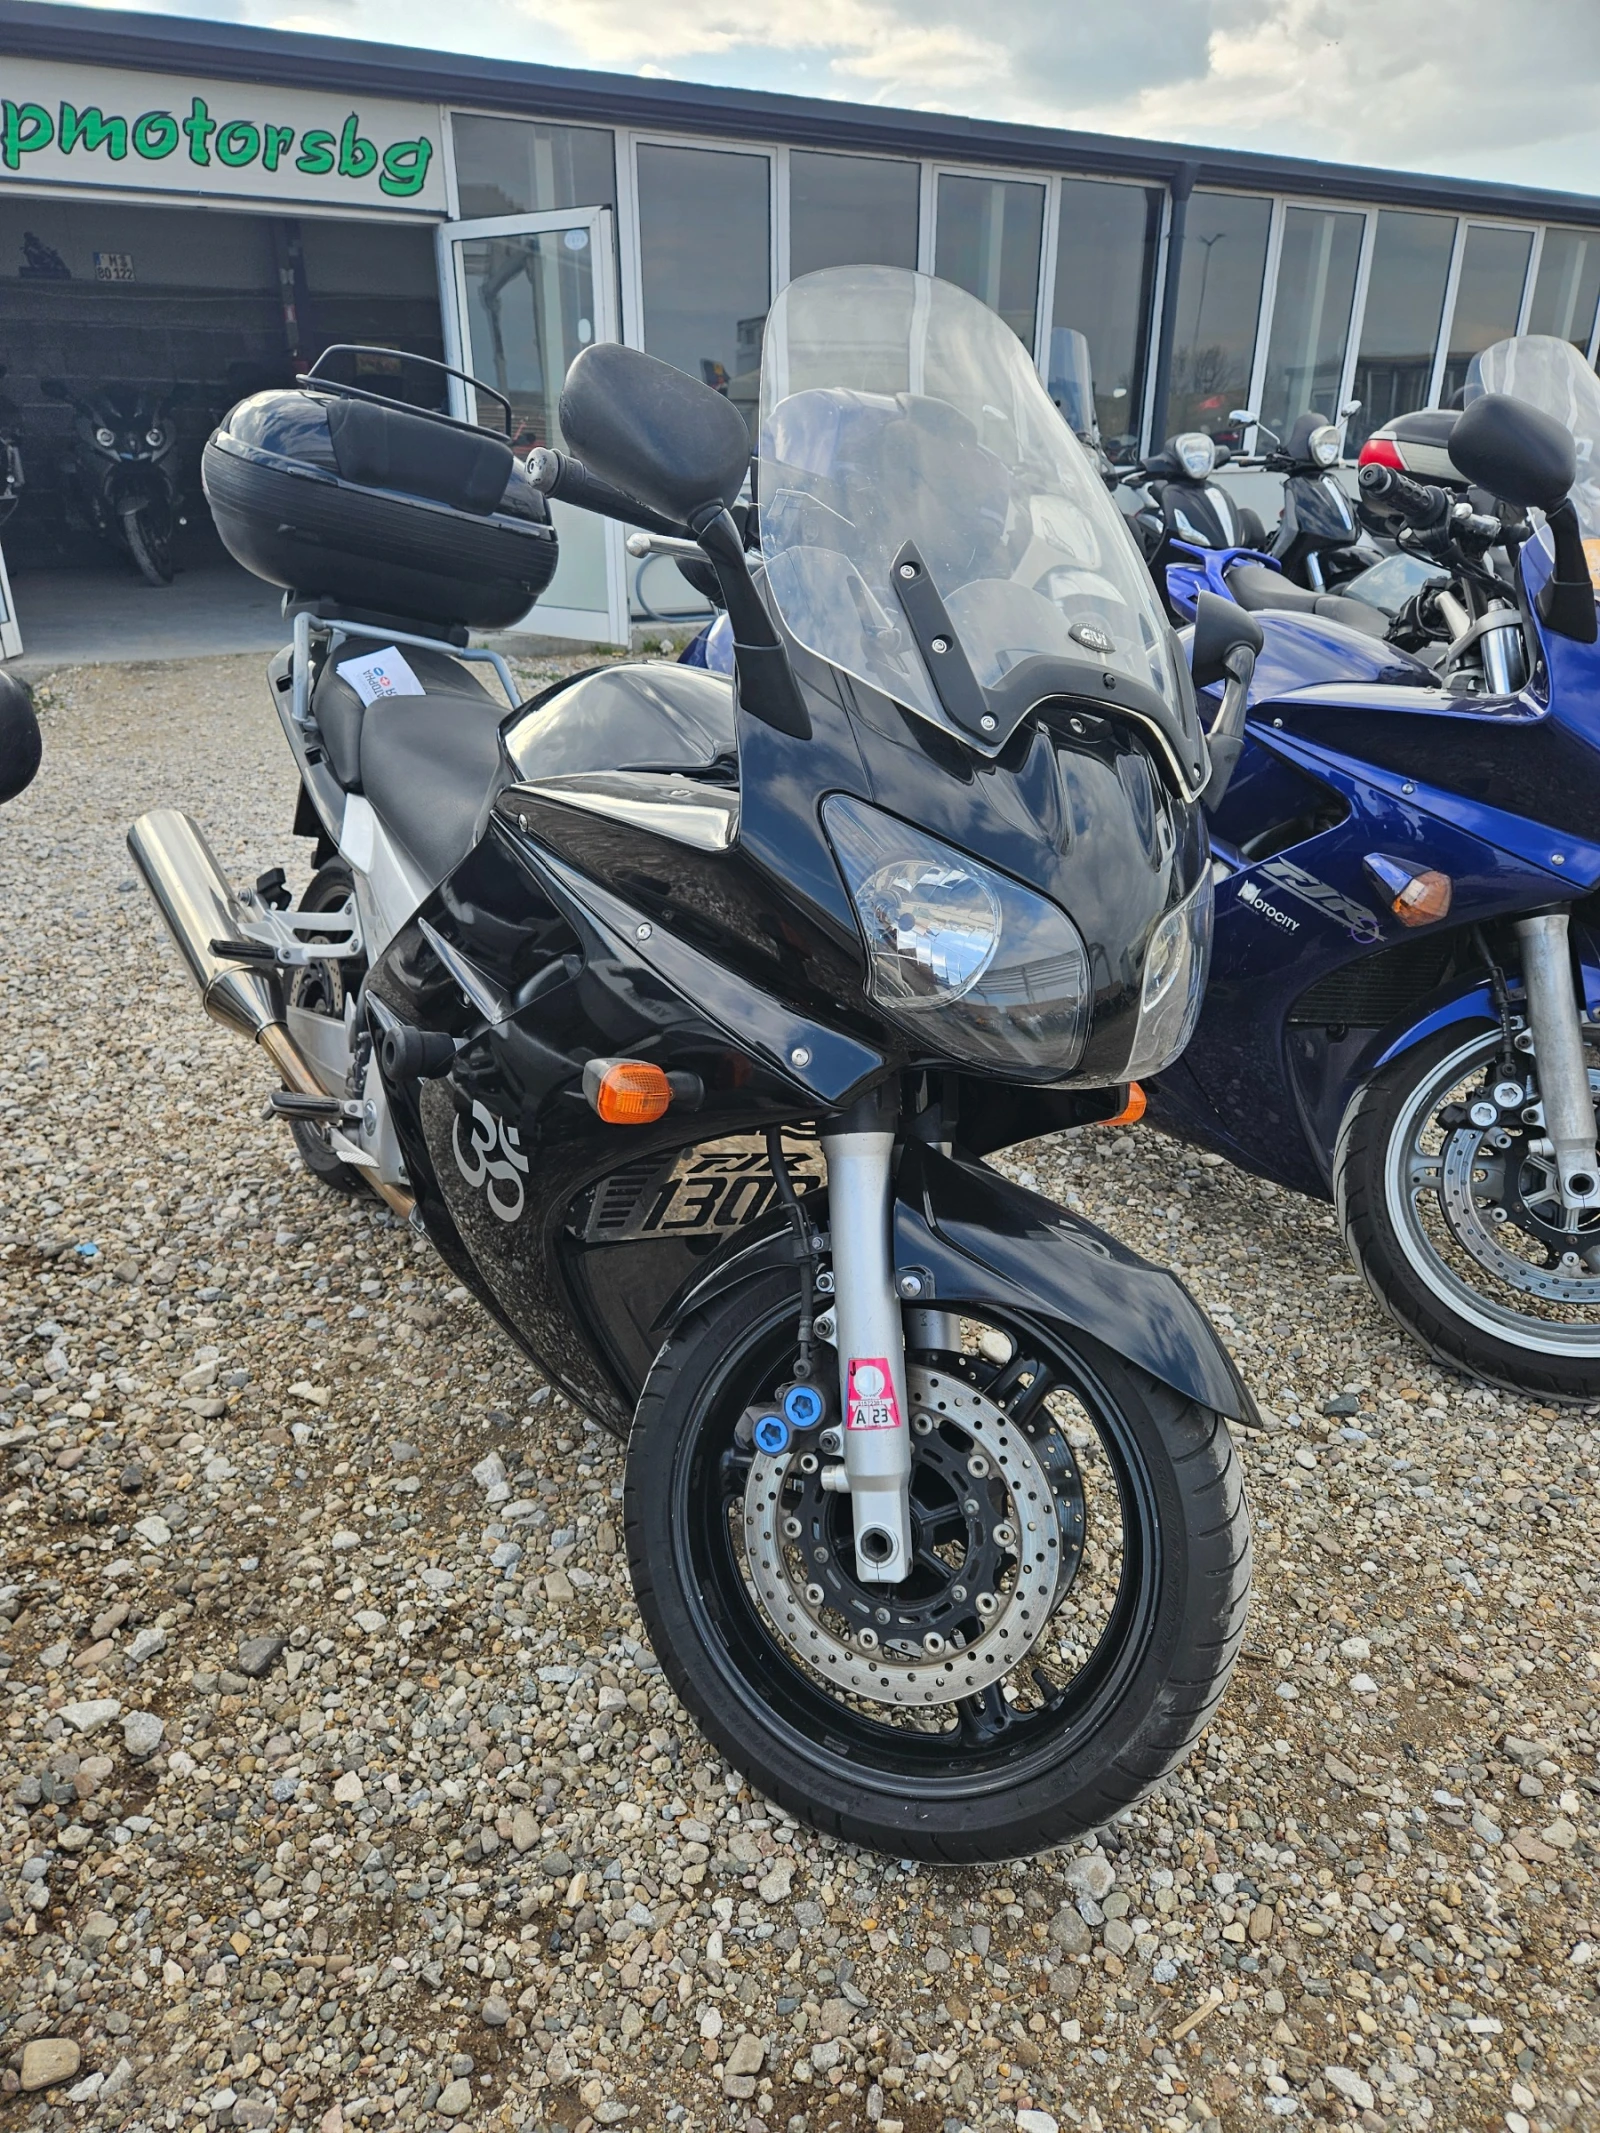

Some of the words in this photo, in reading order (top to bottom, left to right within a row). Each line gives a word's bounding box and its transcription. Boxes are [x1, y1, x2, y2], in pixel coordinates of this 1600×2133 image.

[1, 96, 433, 197] pmotorsbg
[1080, 627, 1108, 646] GIVI
[1237, 879, 1301, 931] MOTOCITY
[686, 1153, 813, 1173] FJR
[856, 1409, 866, 1424] A
[873, 1408, 888, 1424] 23
